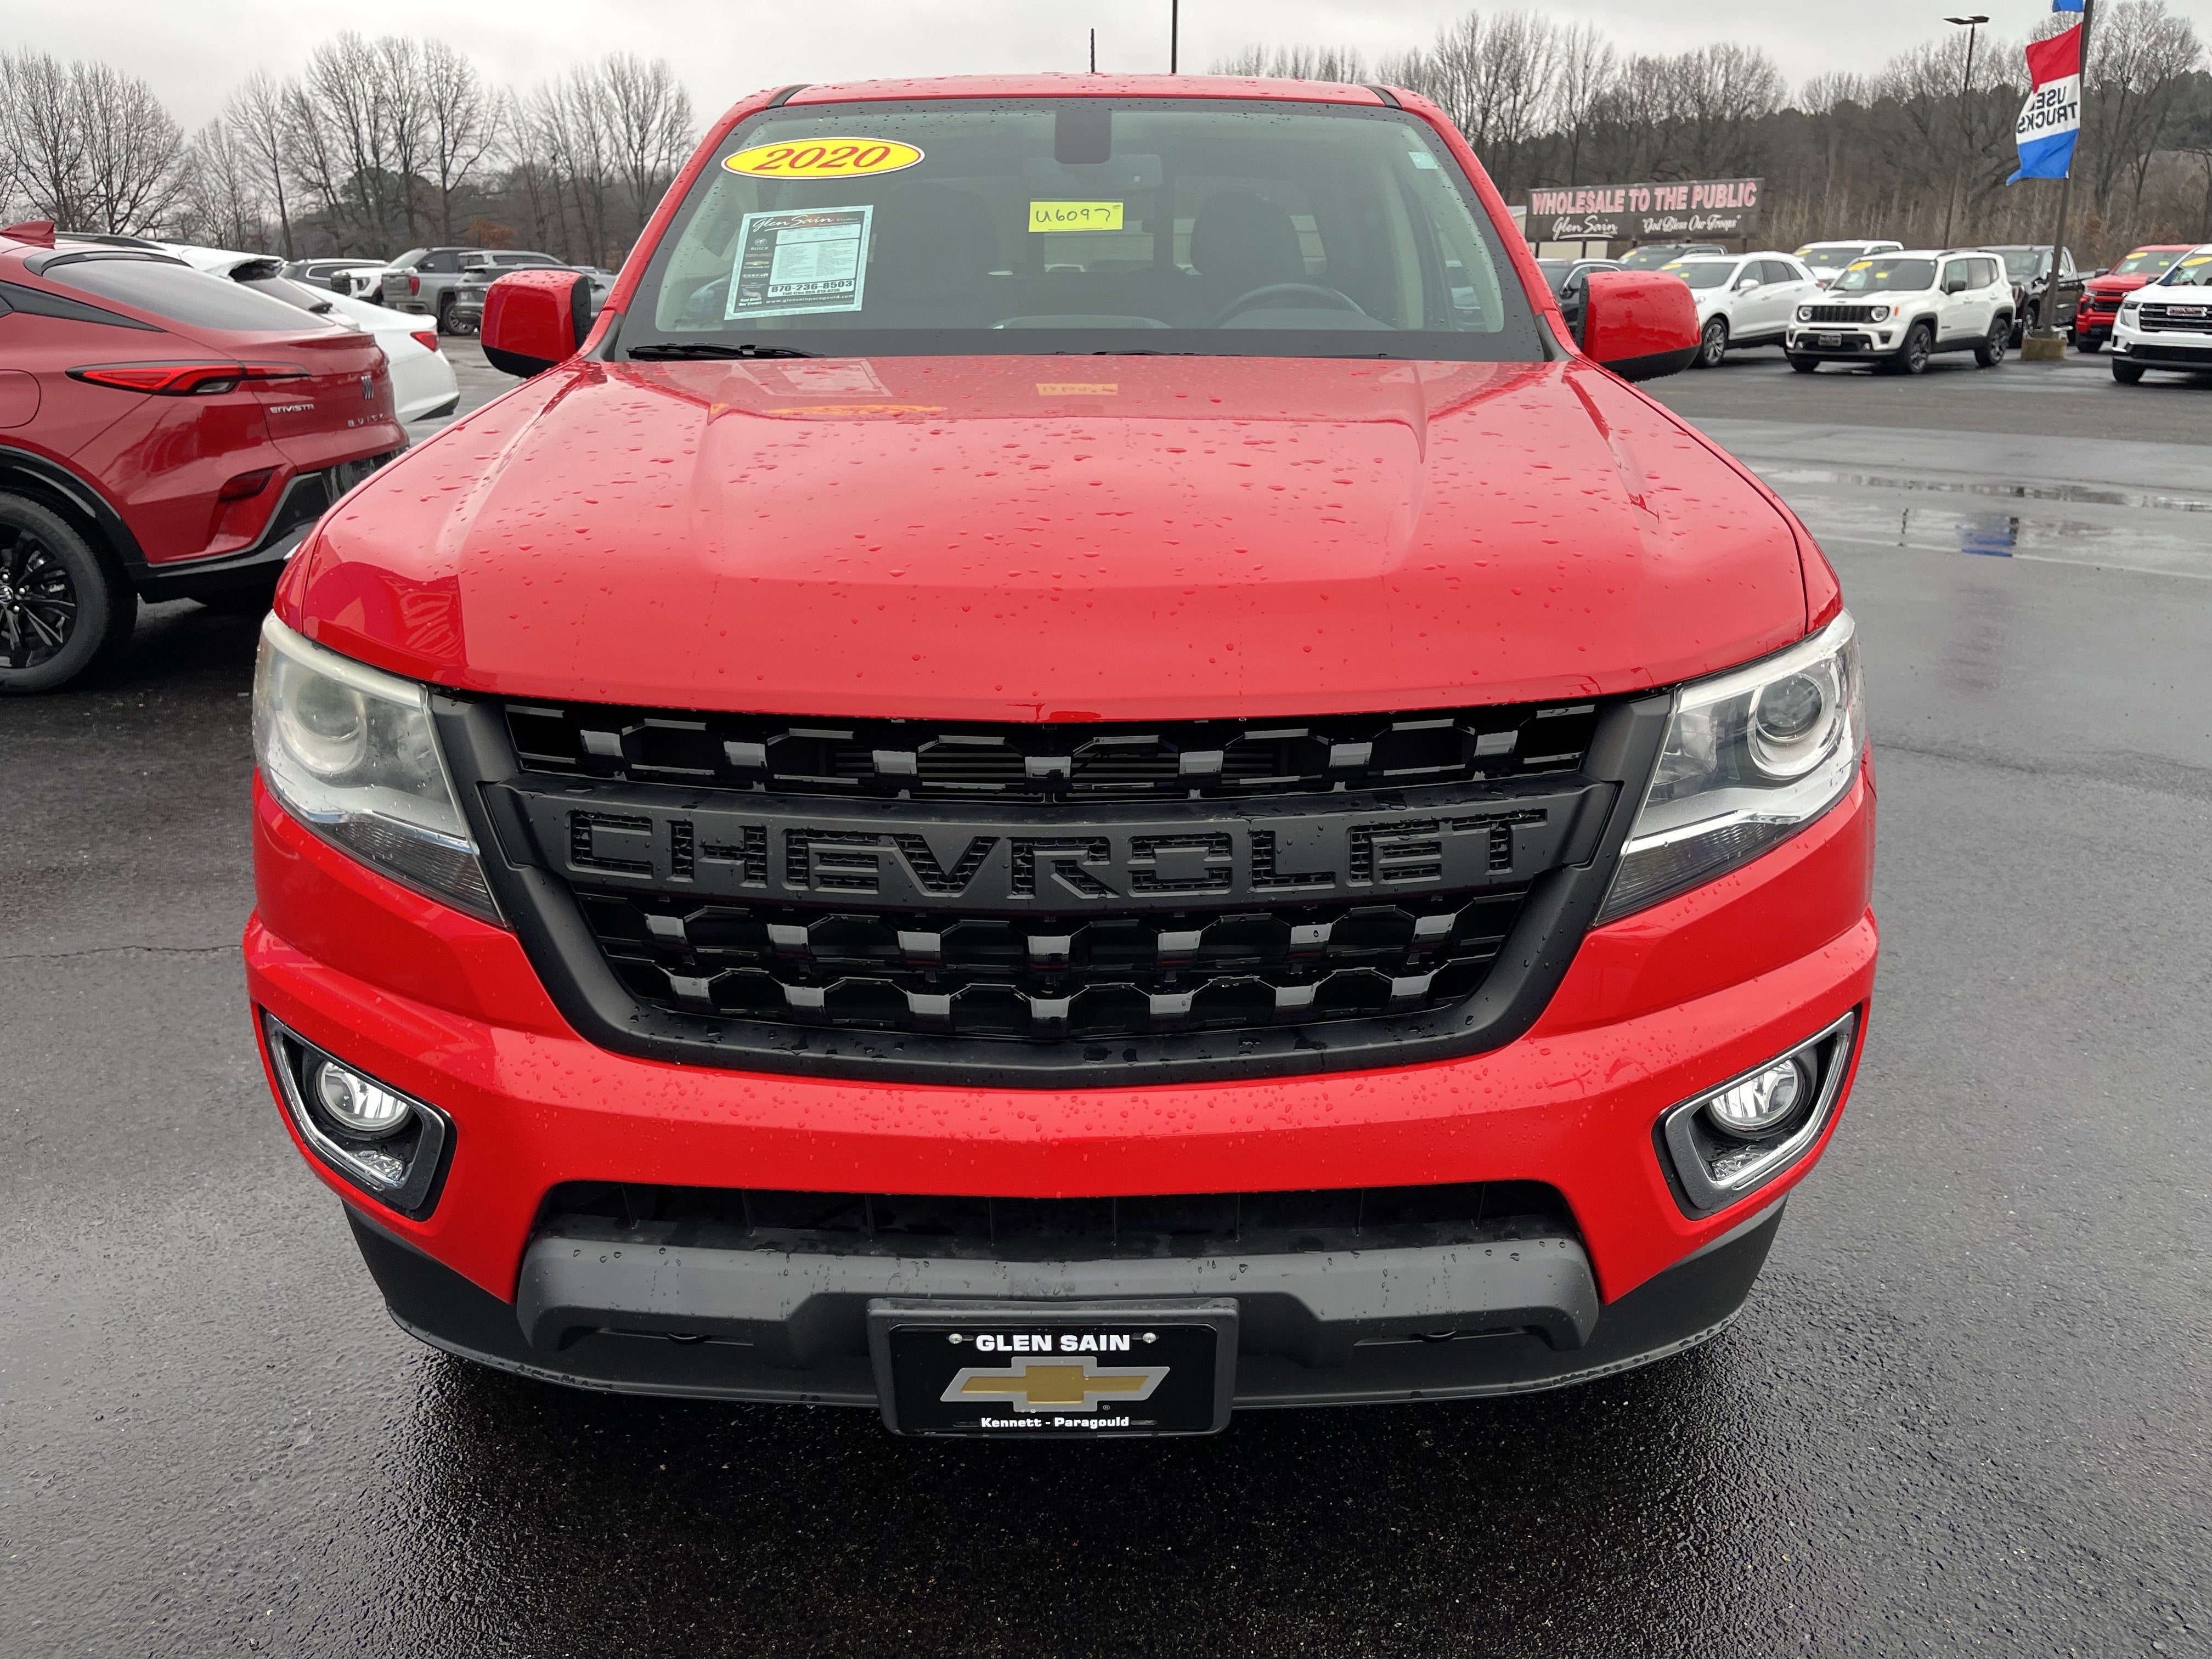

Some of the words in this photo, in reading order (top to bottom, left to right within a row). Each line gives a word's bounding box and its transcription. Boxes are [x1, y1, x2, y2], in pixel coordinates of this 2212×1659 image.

[752, 146, 891, 171] 2020
[1532, 189, 1626, 215] WHOLESALE
[1629, 188, 1650, 212] TO
[1654, 185, 1689, 211] THE
[1691, 182, 1757, 209] PUBLIC
[752, 217, 791, 233] Glen
[791, 215, 834, 227] Sain
[1552, 216, 1583, 241] Glen
[1583, 215, 1618, 234] Sain
[771, 280, 853, 293] 870-236-8503
[270, 403, 315, 414] ENVISTA
[347, 413, 383, 428] BUICK
[565, 809, 1547, 899] CHEVROLET
[976, 1334, 1052, 1352] GLEN
[1060, 1334, 1130, 1351] SAIN
[981, 1417, 1042, 1428] Kennett
[1054, 1416, 1130, 1429] Paragould
